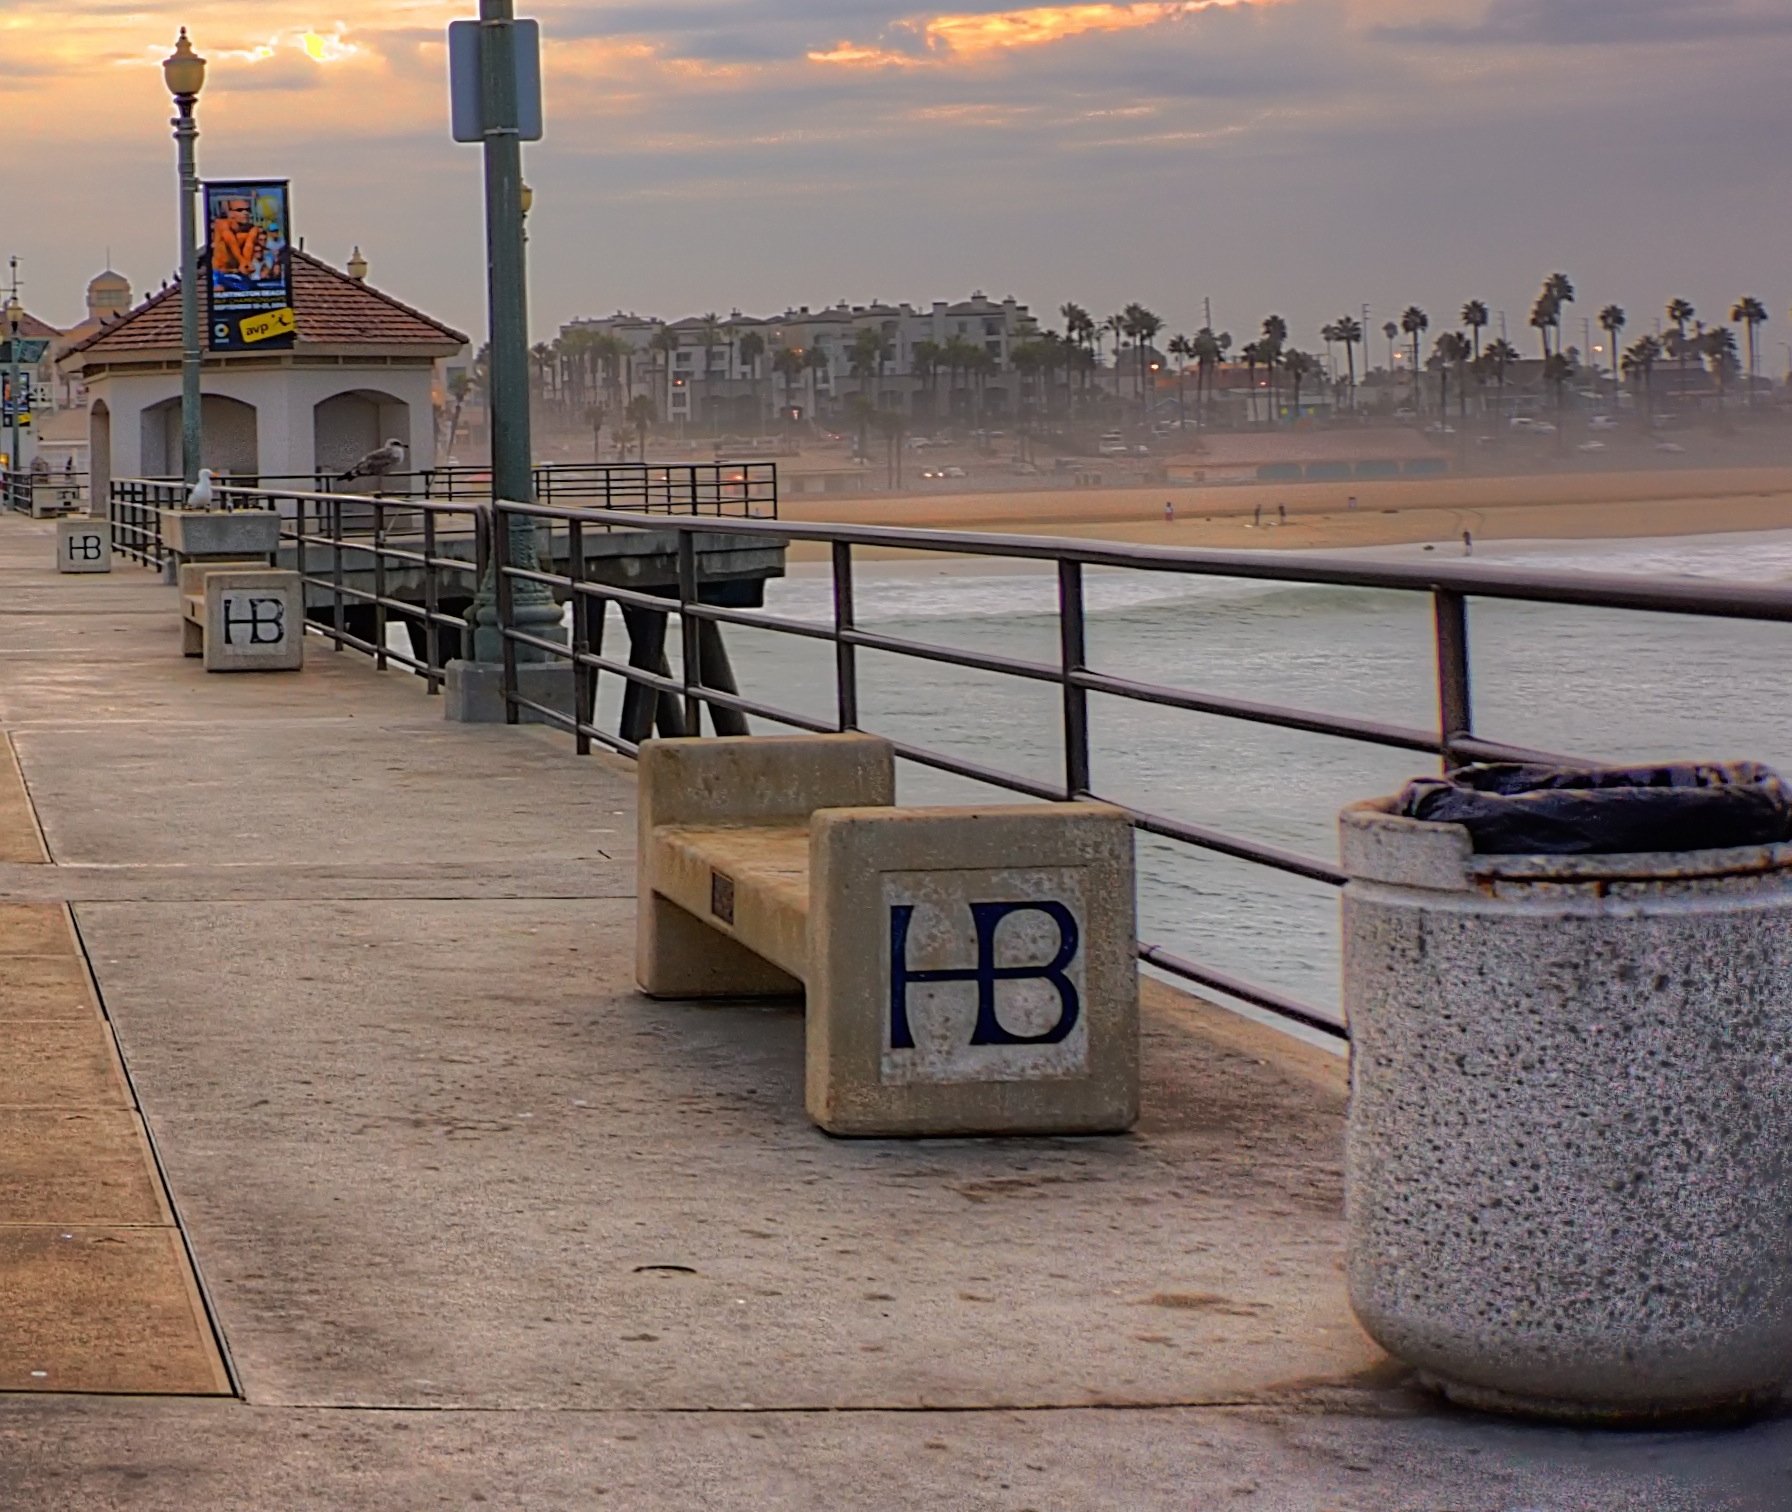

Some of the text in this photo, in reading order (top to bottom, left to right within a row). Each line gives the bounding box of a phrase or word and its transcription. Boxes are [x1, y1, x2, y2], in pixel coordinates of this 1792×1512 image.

[246, 324, 269, 335] avp
[69, 535, 101, 560] HB
[224, 598, 285, 644] HB
[890, 901, 1079, 1049] HB
